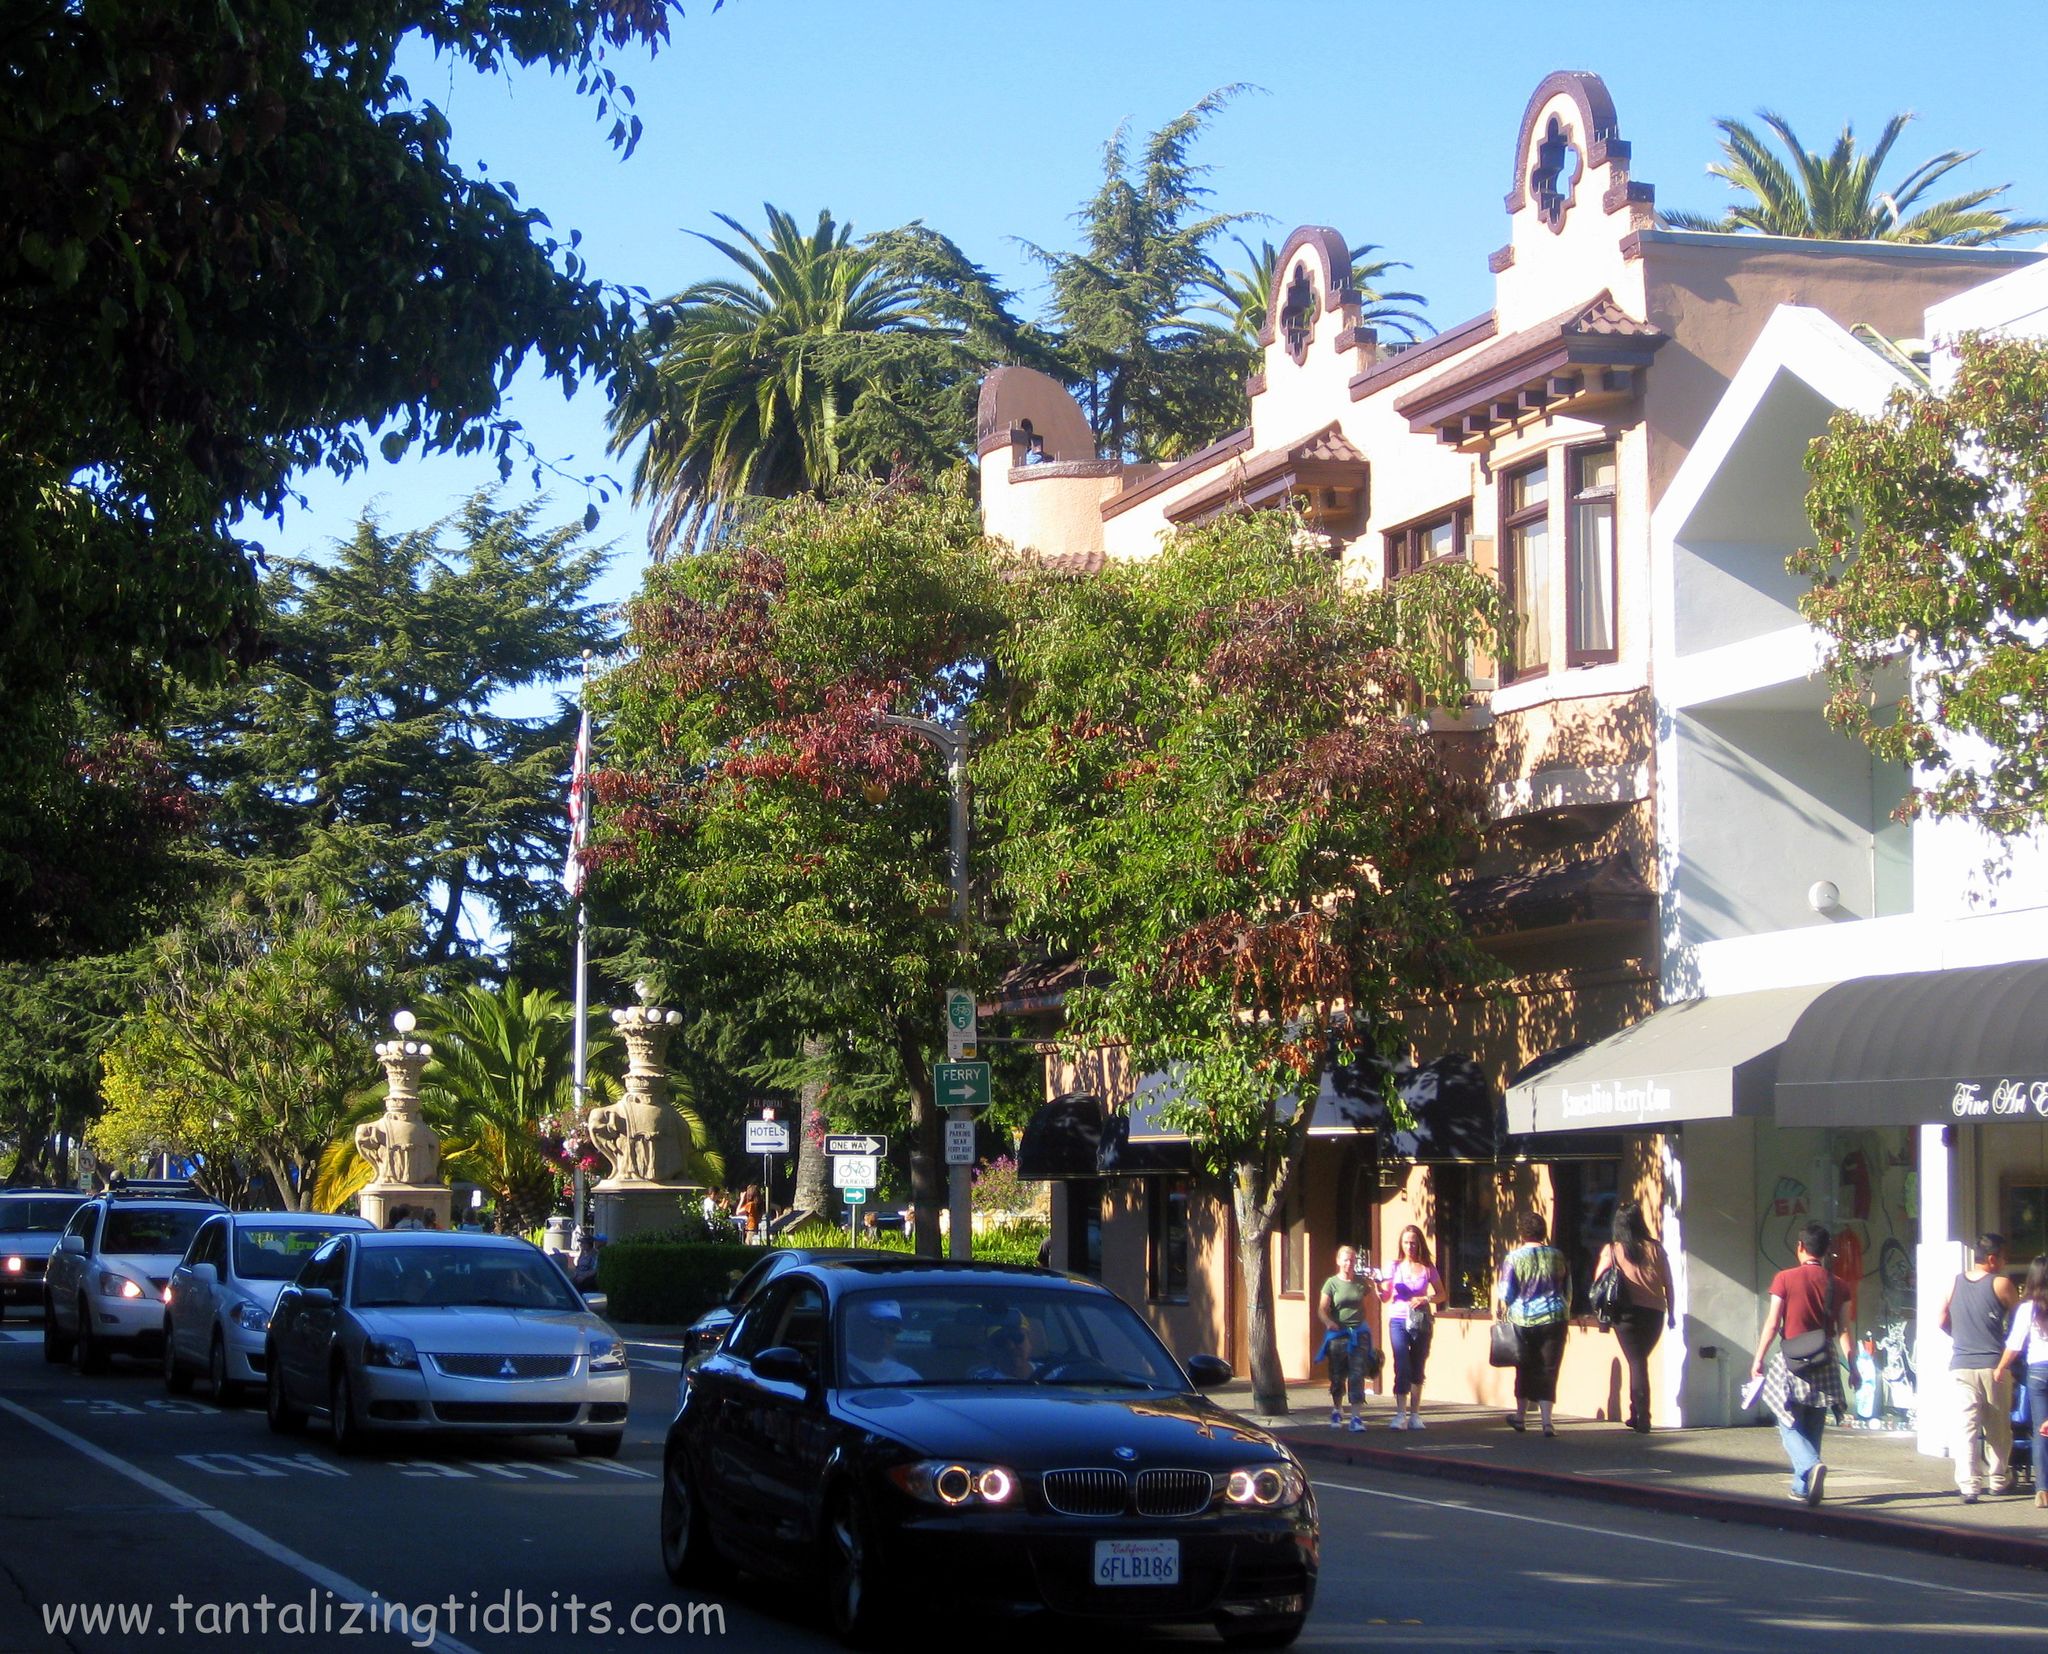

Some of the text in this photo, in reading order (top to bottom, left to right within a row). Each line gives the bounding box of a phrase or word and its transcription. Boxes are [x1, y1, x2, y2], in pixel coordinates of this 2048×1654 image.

[958, 1016, 966, 1028] 5
[943, 1069, 981, 1081] FERRY
[1952, 1082, 1990, 1116] Fine
[1992, 1079, 2027, 1114] Art
[750, 1127, 785, 1136] HOTELS
[832, 1141, 868, 1150] ONE WAY
[1112, 1543, 1161, 1556] California
[1101, 1556, 1173, 1578] 6FLB186
